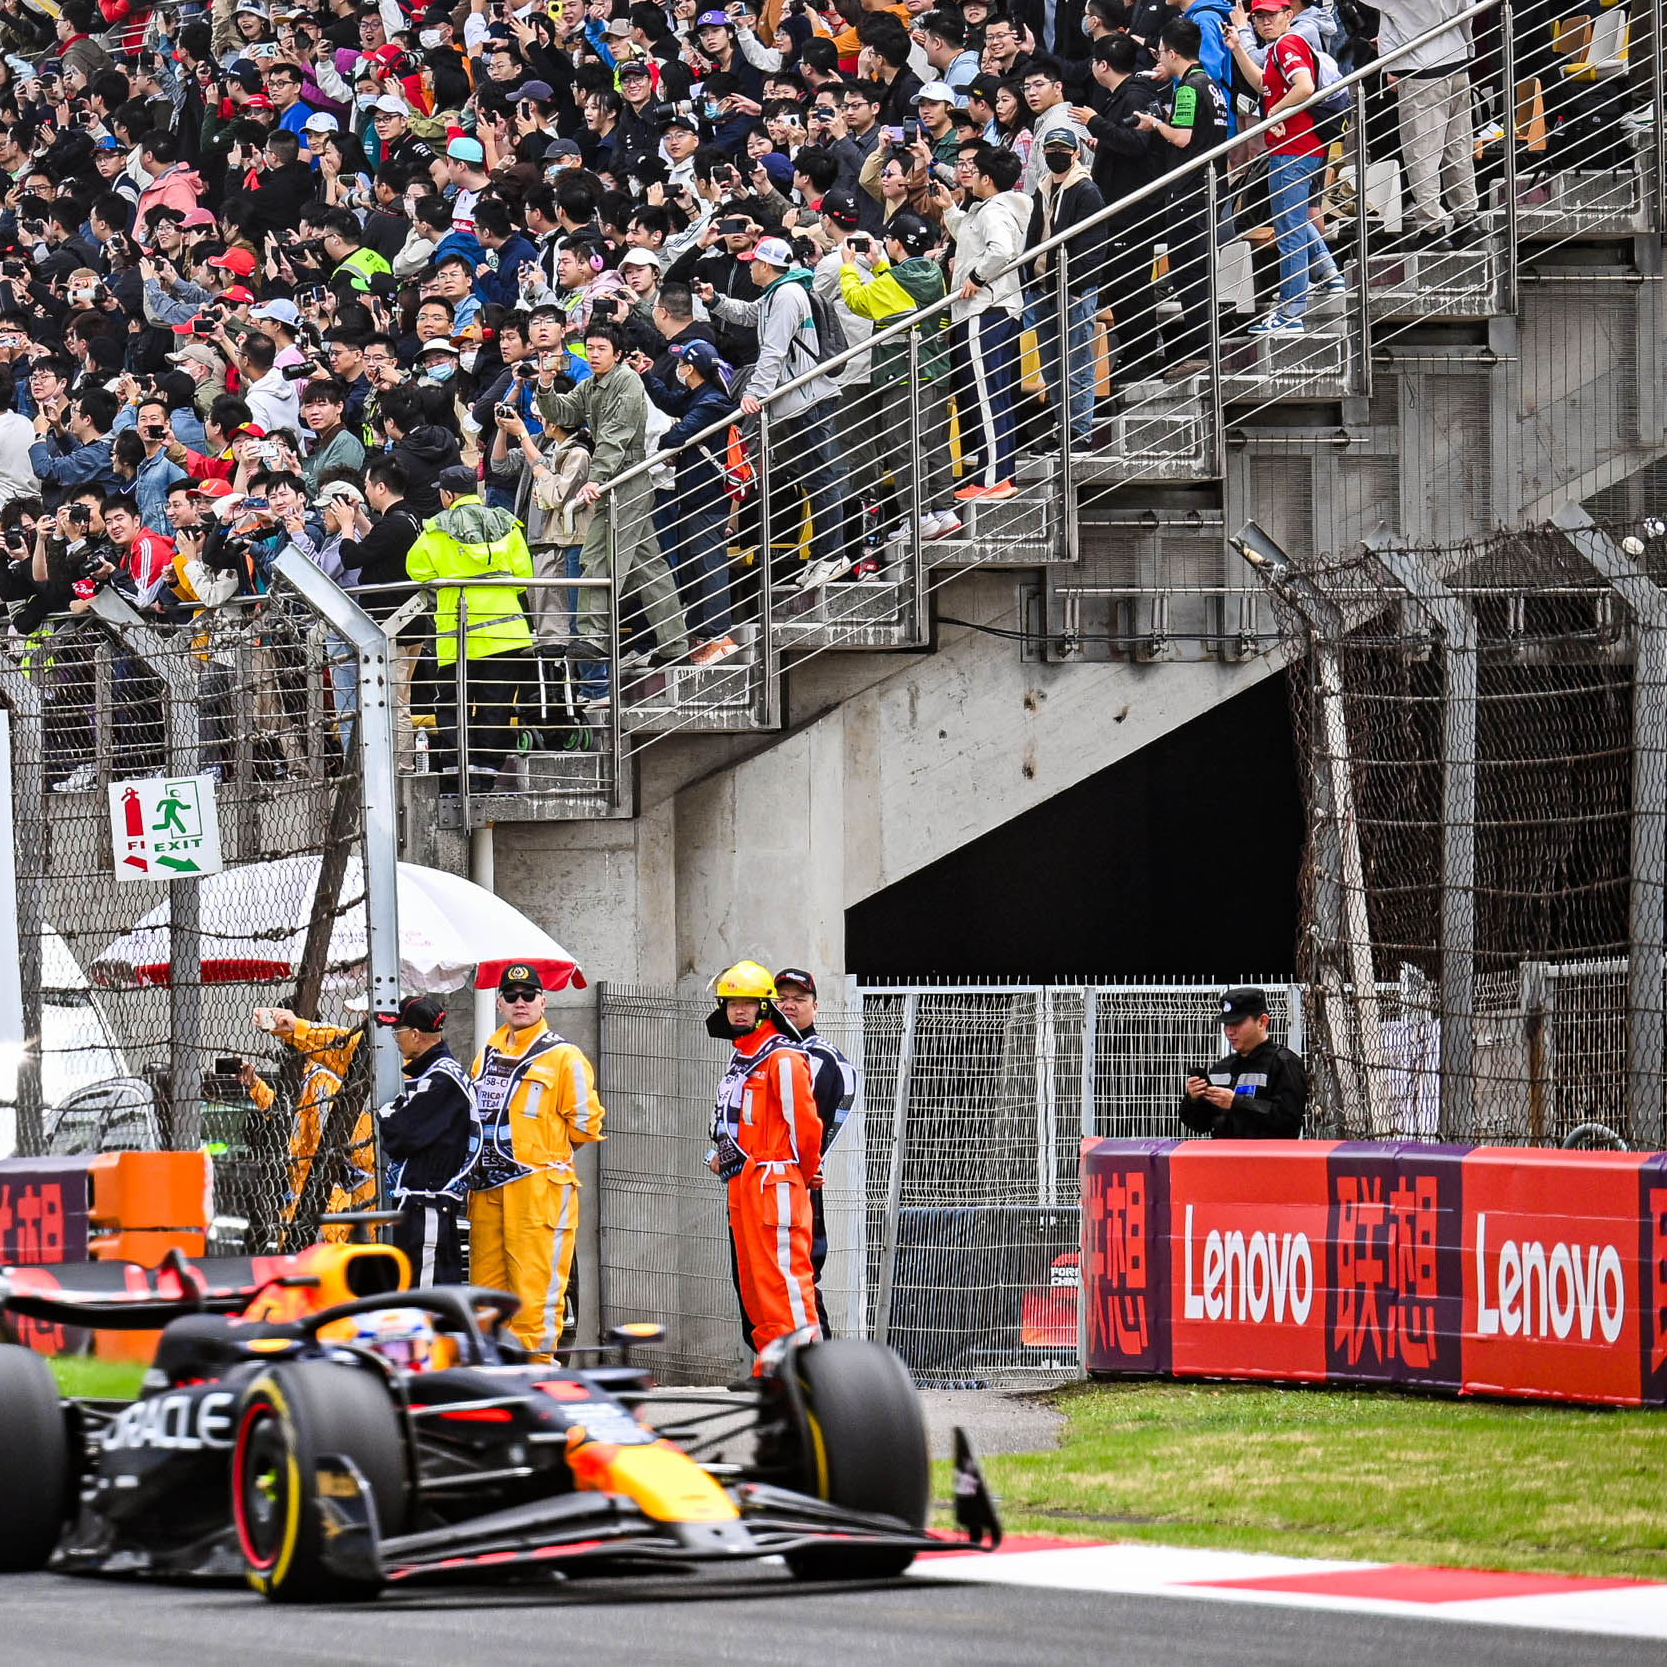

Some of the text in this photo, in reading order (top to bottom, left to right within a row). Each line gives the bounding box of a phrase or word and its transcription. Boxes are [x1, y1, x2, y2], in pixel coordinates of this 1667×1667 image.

[154, 838, 203, 852] EXIT
[486, 1077, 509, 1088] 58-C
[477, 1156, 506, 1167] ESS
[1184, 1204, 1313, 1326] Lenovo
[1334, 1175, 1438, 1369] 联想
[1476, 1213, 1625, 1344] Lenovo
